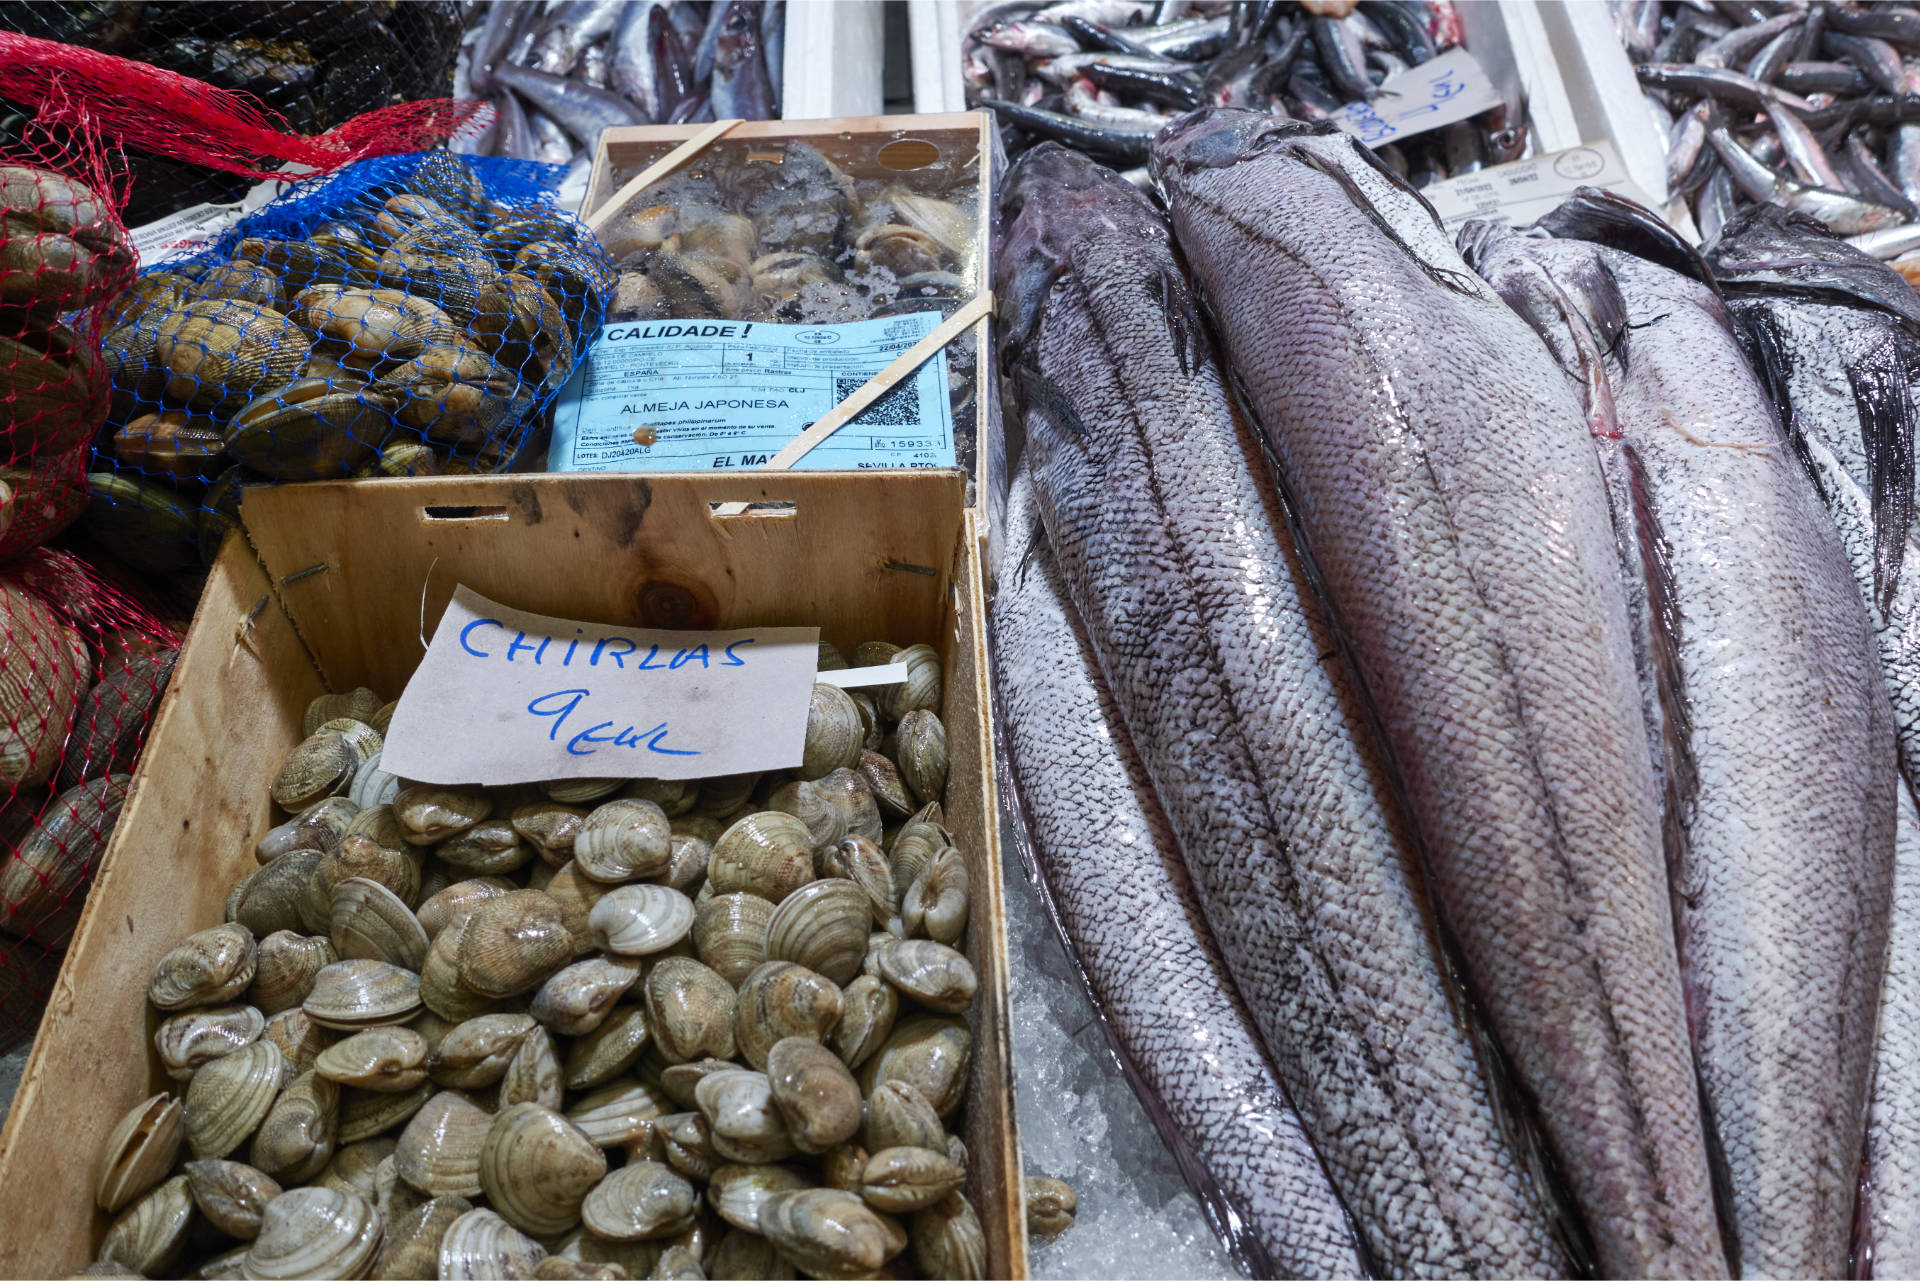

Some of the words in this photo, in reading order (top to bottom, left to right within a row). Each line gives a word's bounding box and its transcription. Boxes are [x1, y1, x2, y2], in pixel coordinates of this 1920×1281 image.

[746, 352, 753, 361] 1
[624, 369, 659, 378] ESPAÑA
[620, 401, 690, 415] ALMEJA
[694, 399, 789, 410] JAPONESA
[713, 456, 735, 468] EL
[527, 688, 590, 741] 9
